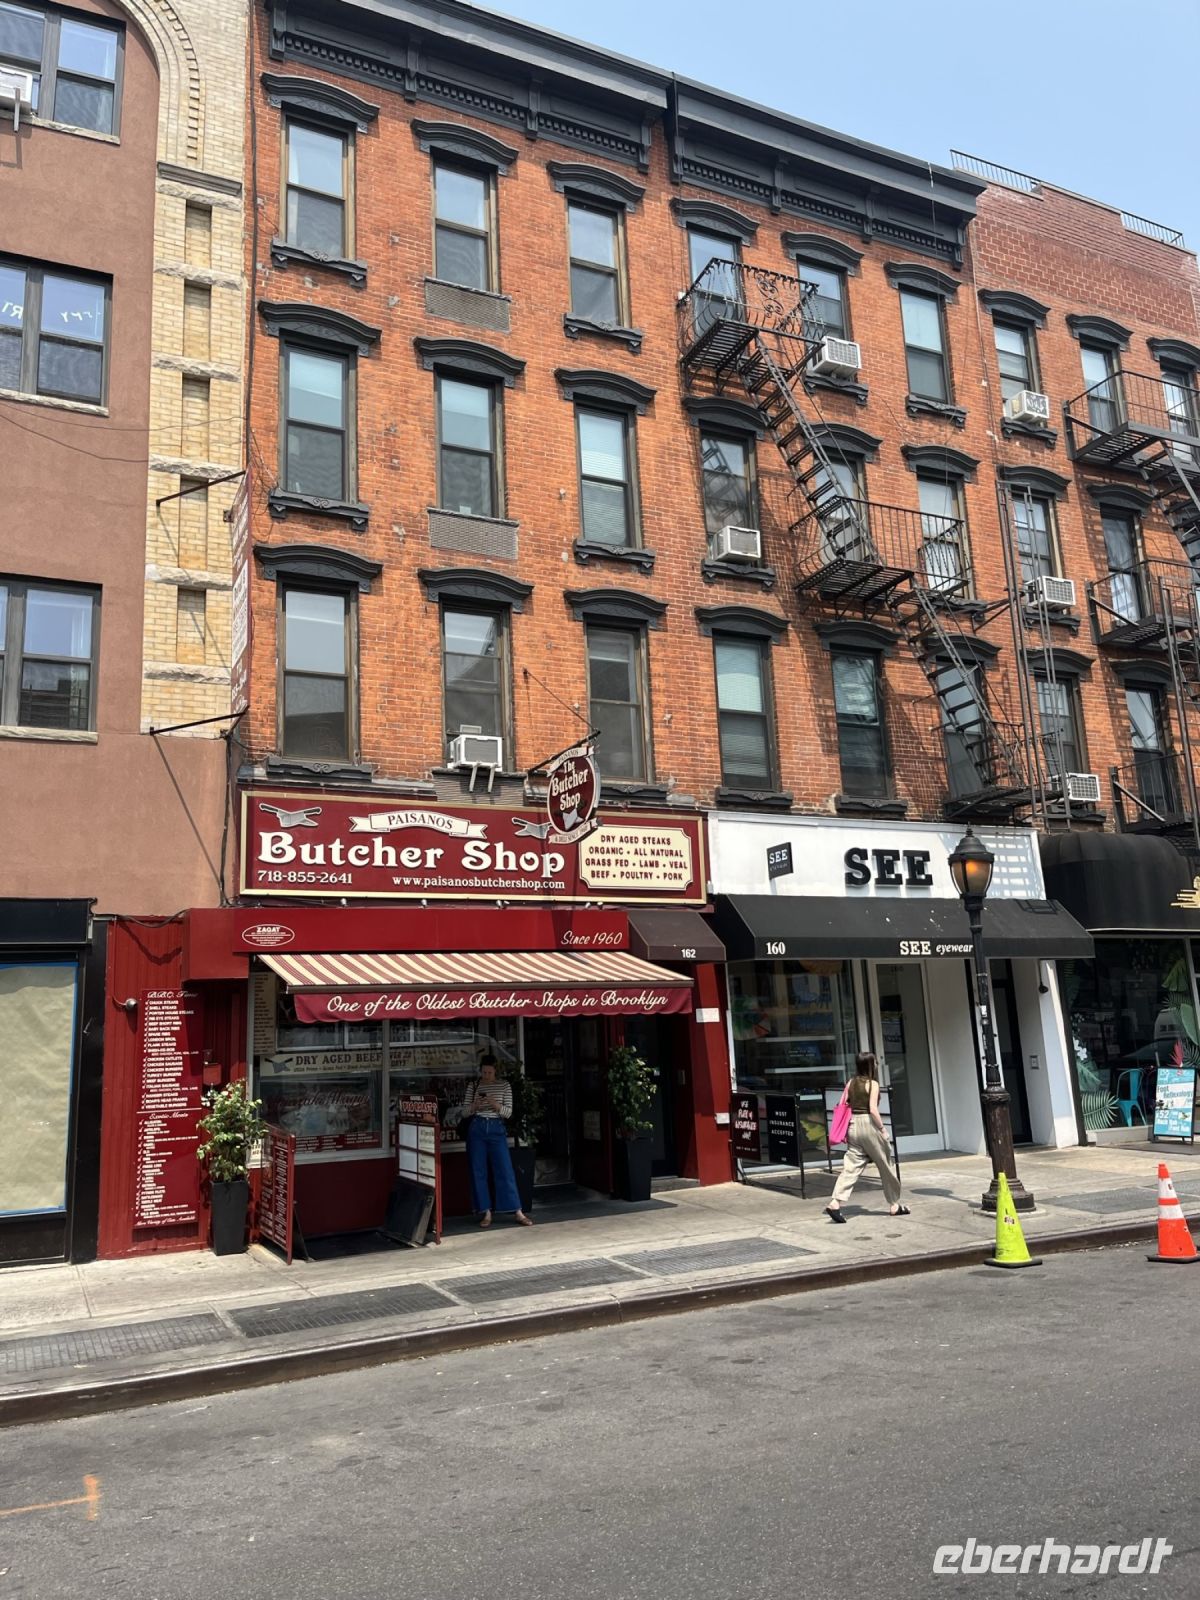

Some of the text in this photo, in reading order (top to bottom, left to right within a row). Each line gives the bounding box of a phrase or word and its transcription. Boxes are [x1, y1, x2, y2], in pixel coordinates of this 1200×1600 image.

[563, 760, 575, 774] The
[551, 769, 588, 797] Butcher
[560, 792, 581, 811] Shop
[387, 813, 454, 830] PAISANOS
[600, 834, 671, 846] DRY AGED STEAKS
[257, 831, 566, 878] Butcher Shop
[588, 846, 684, 858] ORGANIC ALL NATURAL
[769, 849, 788, 864] SEE
[585, 858, 688, 870] GRASS FED LAMB VEAL
[844, 847, 934, 887] SEE
[257, 870, 566, 891] 718-855-2641 www.paisanosbutchershop.com
[591, 870, 683, 881] BEEF POULTRY PORK
[561, 930, 623, 946] Since 1960
[681, 948, 696, 958] 162
[765, 941, 786, 955] 160
[900, 941, 974, 955] SEE eyewear
[327, 990, 669, 1017] One of the Oldest Butcher Shops in Brooklyn
[295, 1052, 383, 1066] DRY AGED BEEF
